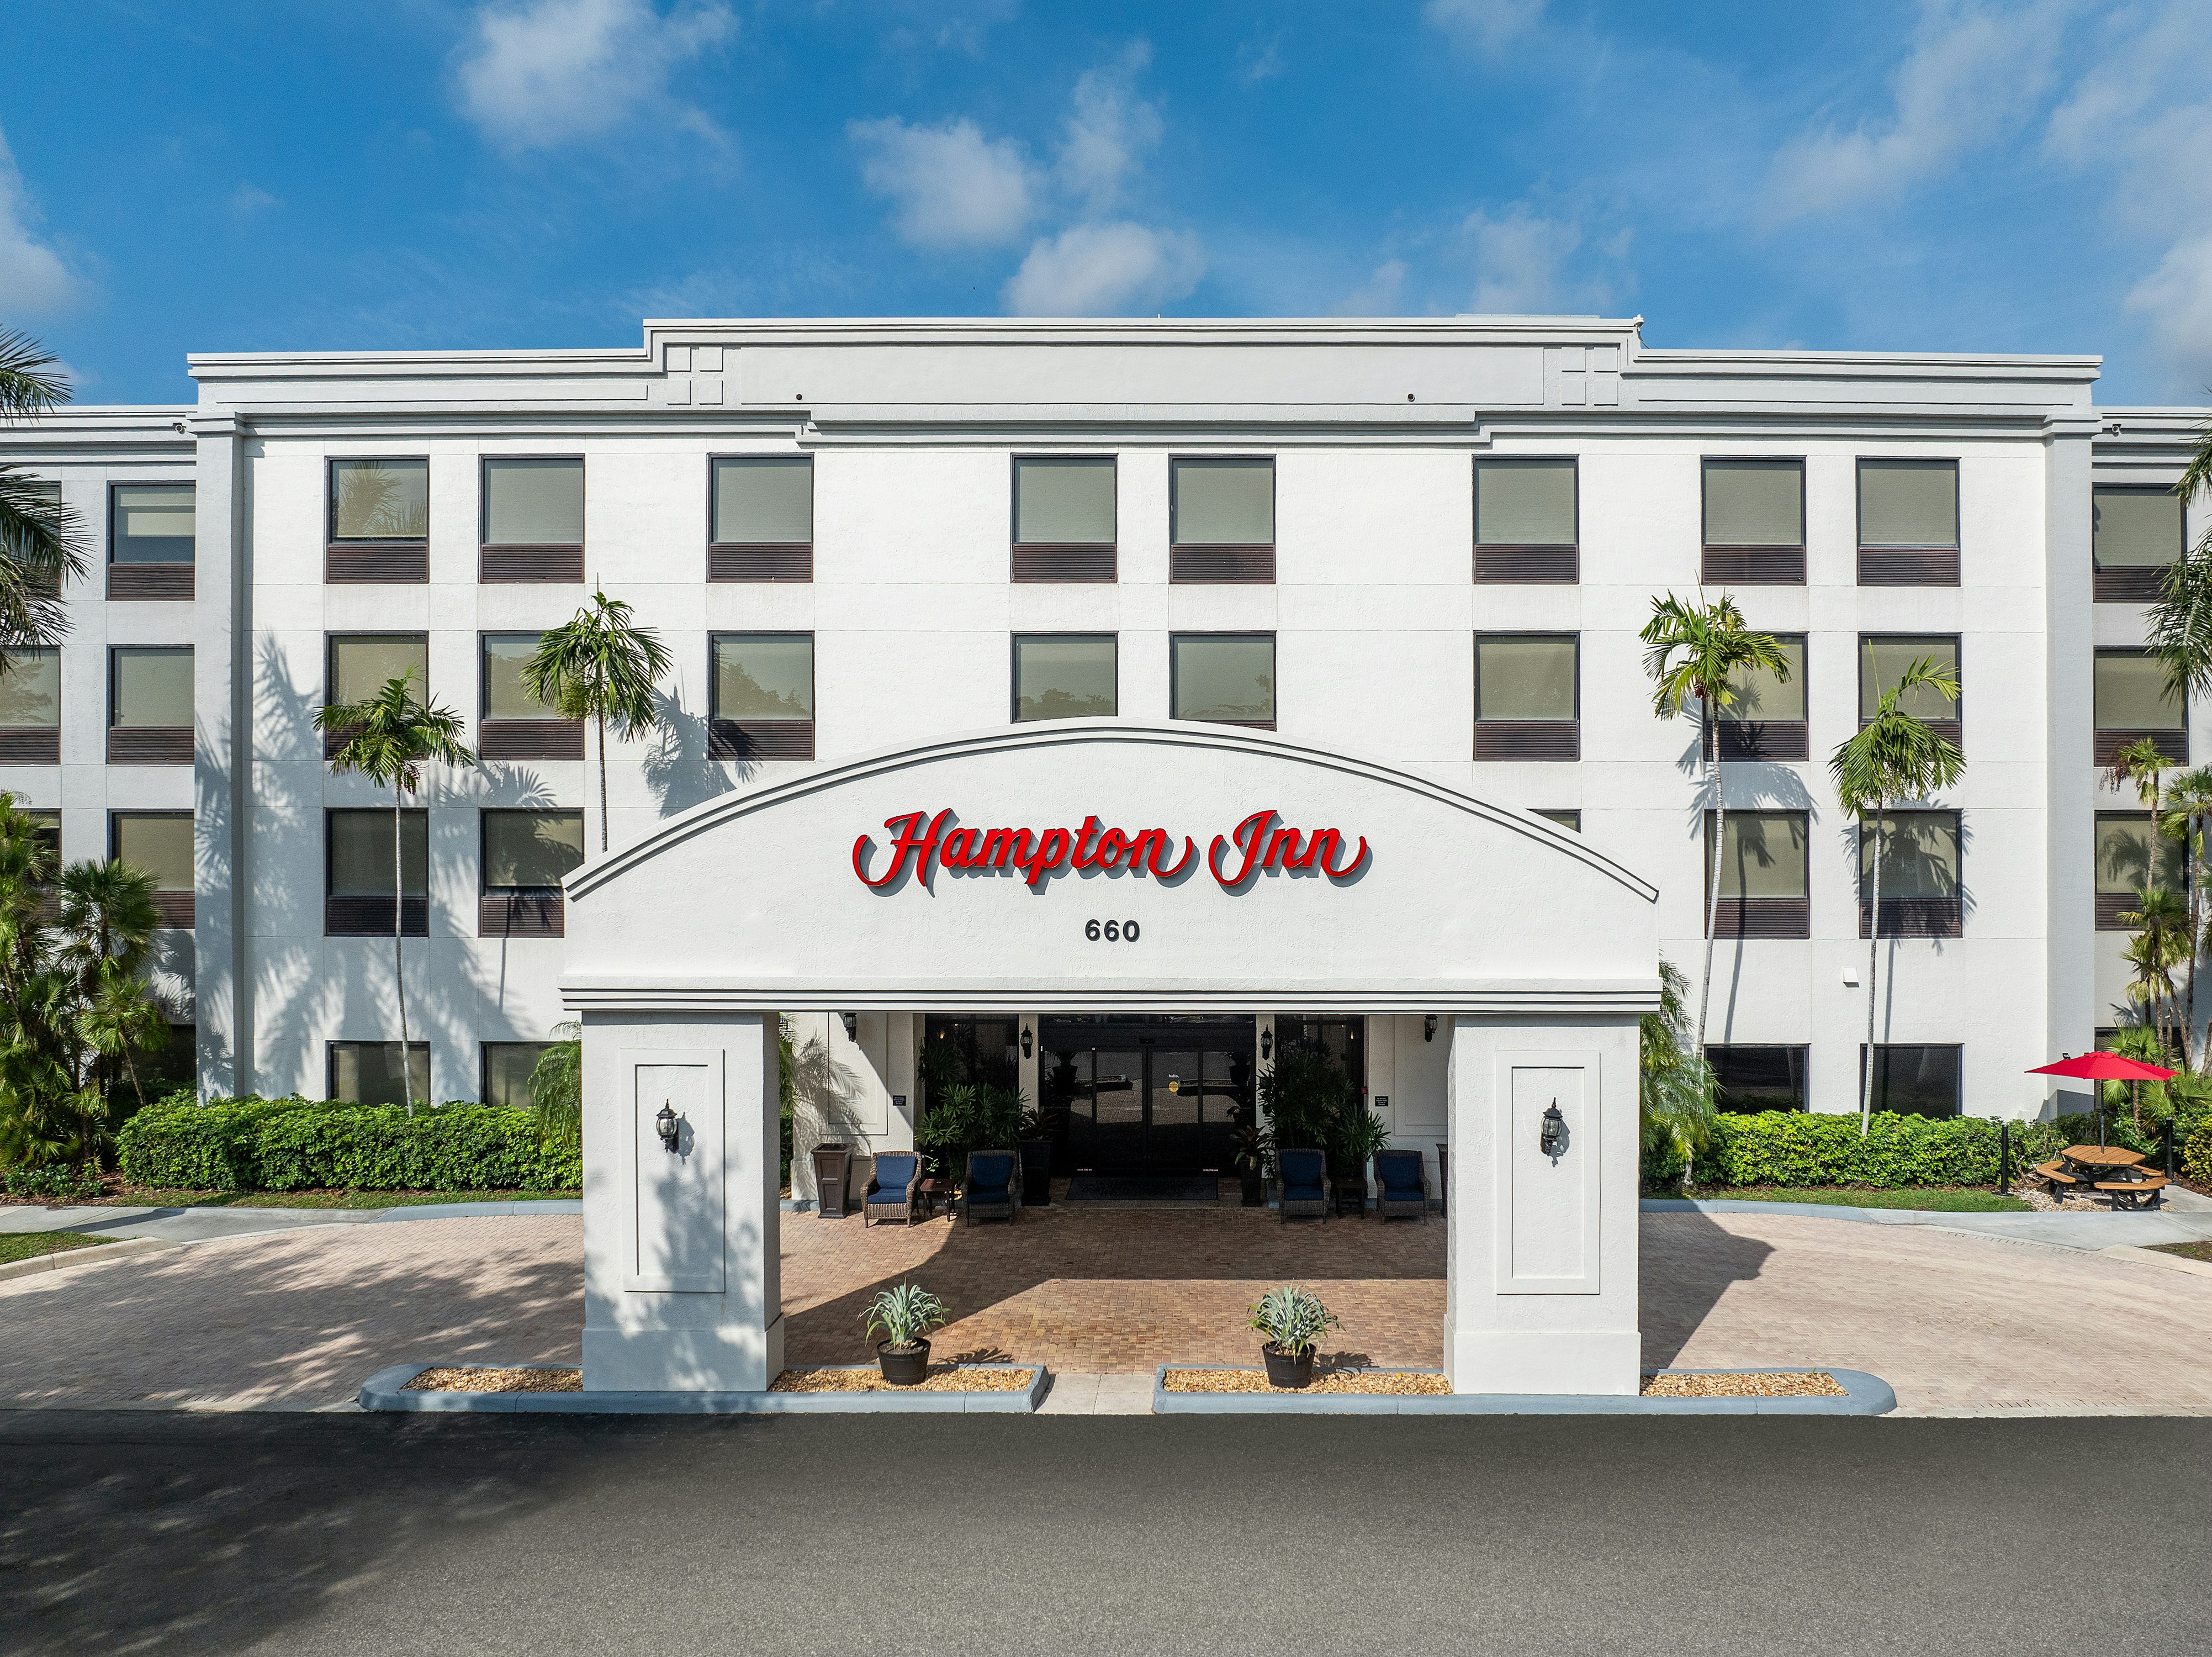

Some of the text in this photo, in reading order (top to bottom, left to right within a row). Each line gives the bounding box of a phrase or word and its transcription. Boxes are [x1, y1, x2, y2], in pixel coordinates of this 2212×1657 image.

[852, 808, 1367, 886] Hampton Inn
[1085, 919, 1140, 942] 660
